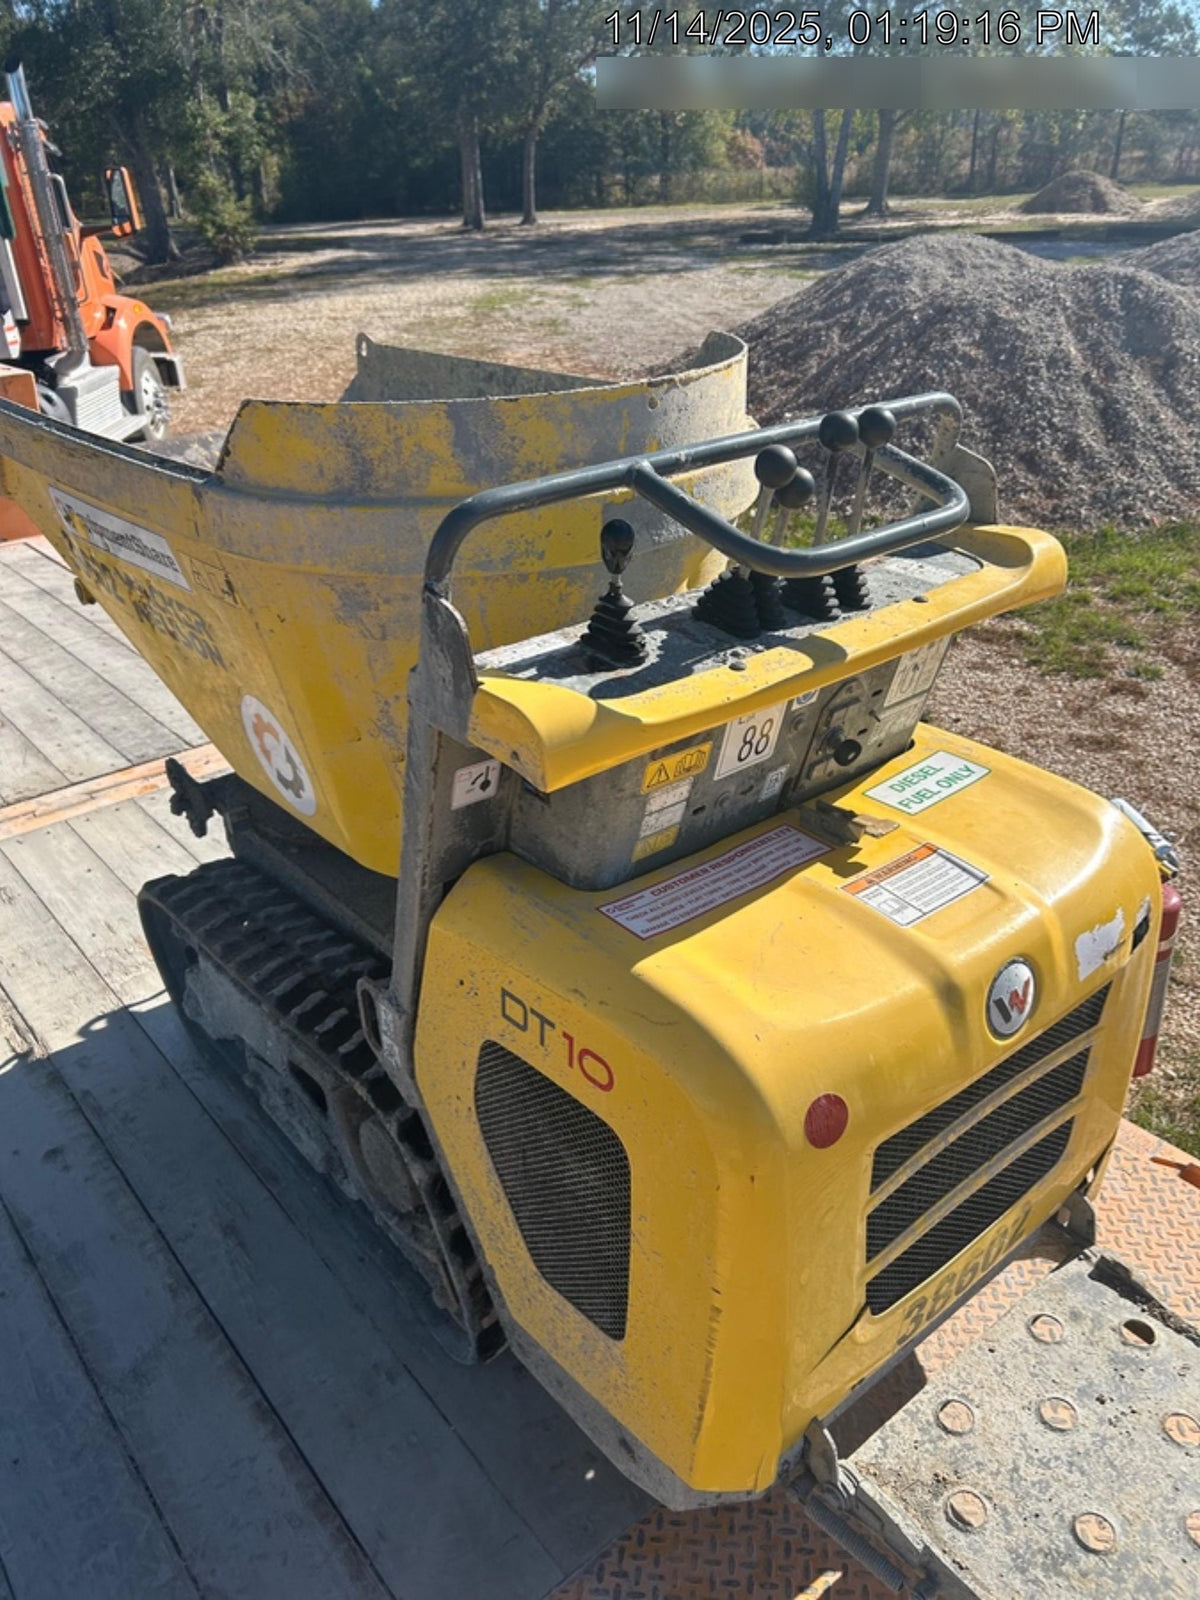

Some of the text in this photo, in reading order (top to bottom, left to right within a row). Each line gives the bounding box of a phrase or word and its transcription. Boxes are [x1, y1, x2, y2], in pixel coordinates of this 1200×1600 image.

[737, 718, 774, 762] 88
[888, 765, 944, 793] DIESEL
[897, 764, 976, 809] FUEL ONLY
[501, 986, 614, 1092] DT10
